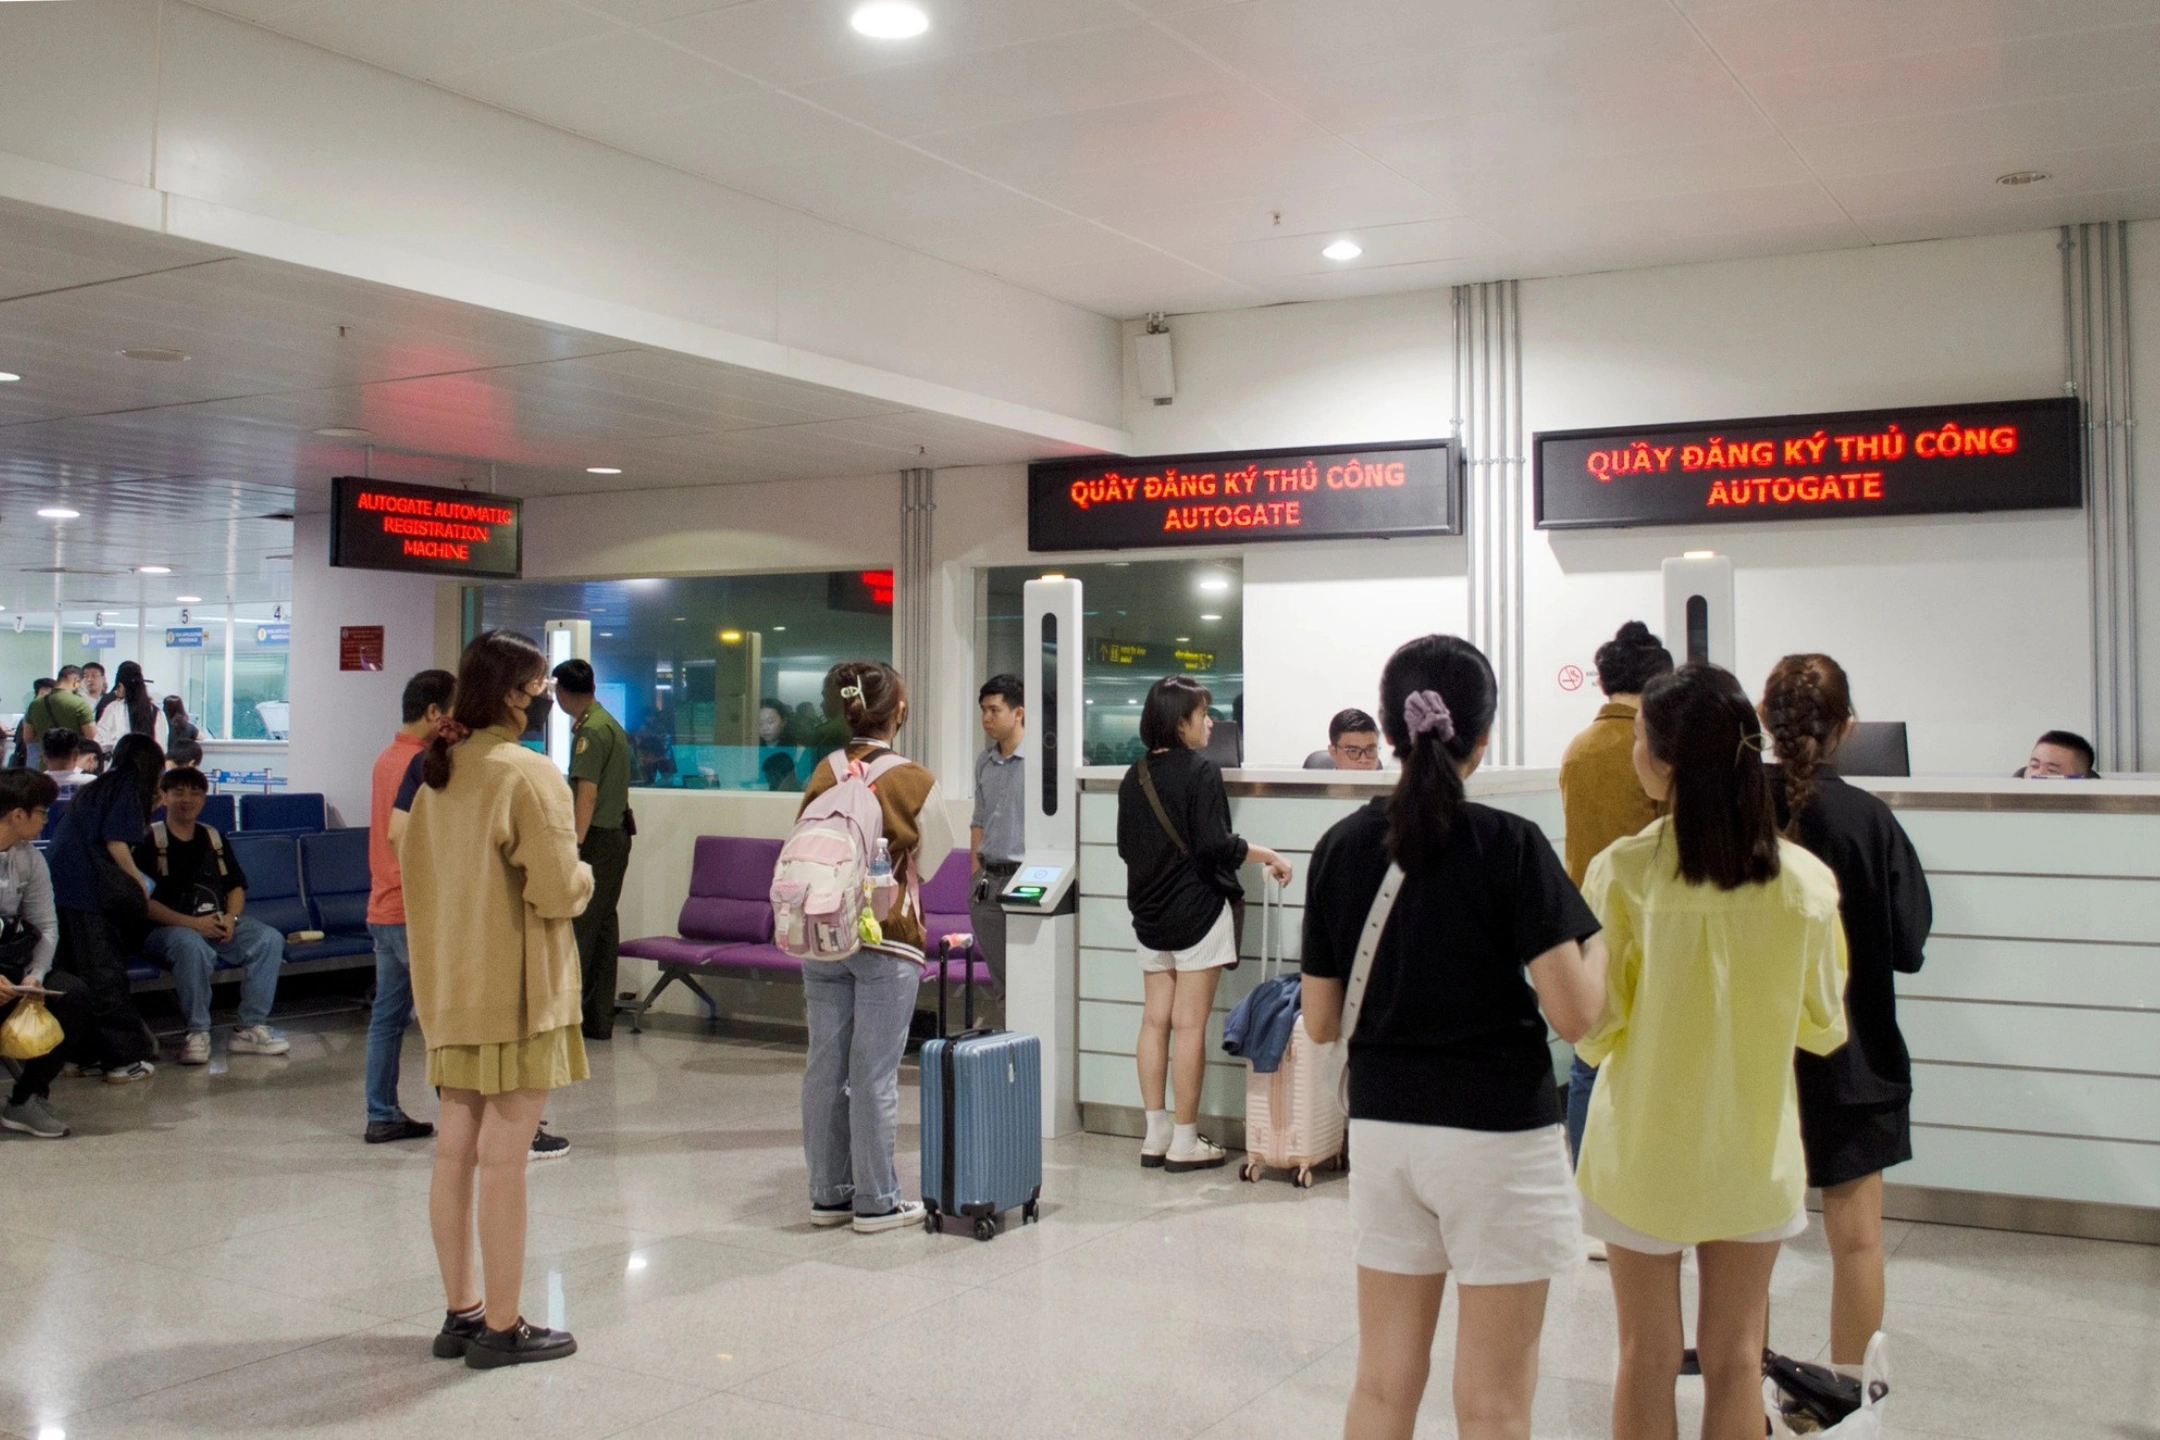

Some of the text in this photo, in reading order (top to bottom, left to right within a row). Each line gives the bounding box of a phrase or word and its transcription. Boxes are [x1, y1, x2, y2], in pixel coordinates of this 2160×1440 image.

[1587, 420, 2017, 482] QUẦY ĐĂNG KÝ THỦ CÔNG
[1070, 458, 1406, 510] QUẦY ĐĂNG KÝ THỦ CÔNG
[1706, 470, 1884, 507] AUTOGATE
[358, 492, 512, 525] AUTOGATE AUTOMATIC
[1163, 501, 1301, 532] AUTOGATE
[383, 516, 490, 542] REGISTRATION
[403, 539, 470, 560] MACHINE
[16, 616, 23, 630] 7
[95, 612, 103, 627] 6
[181, 608, 189, 624] 5
[273, 604, 282, 621] 4
